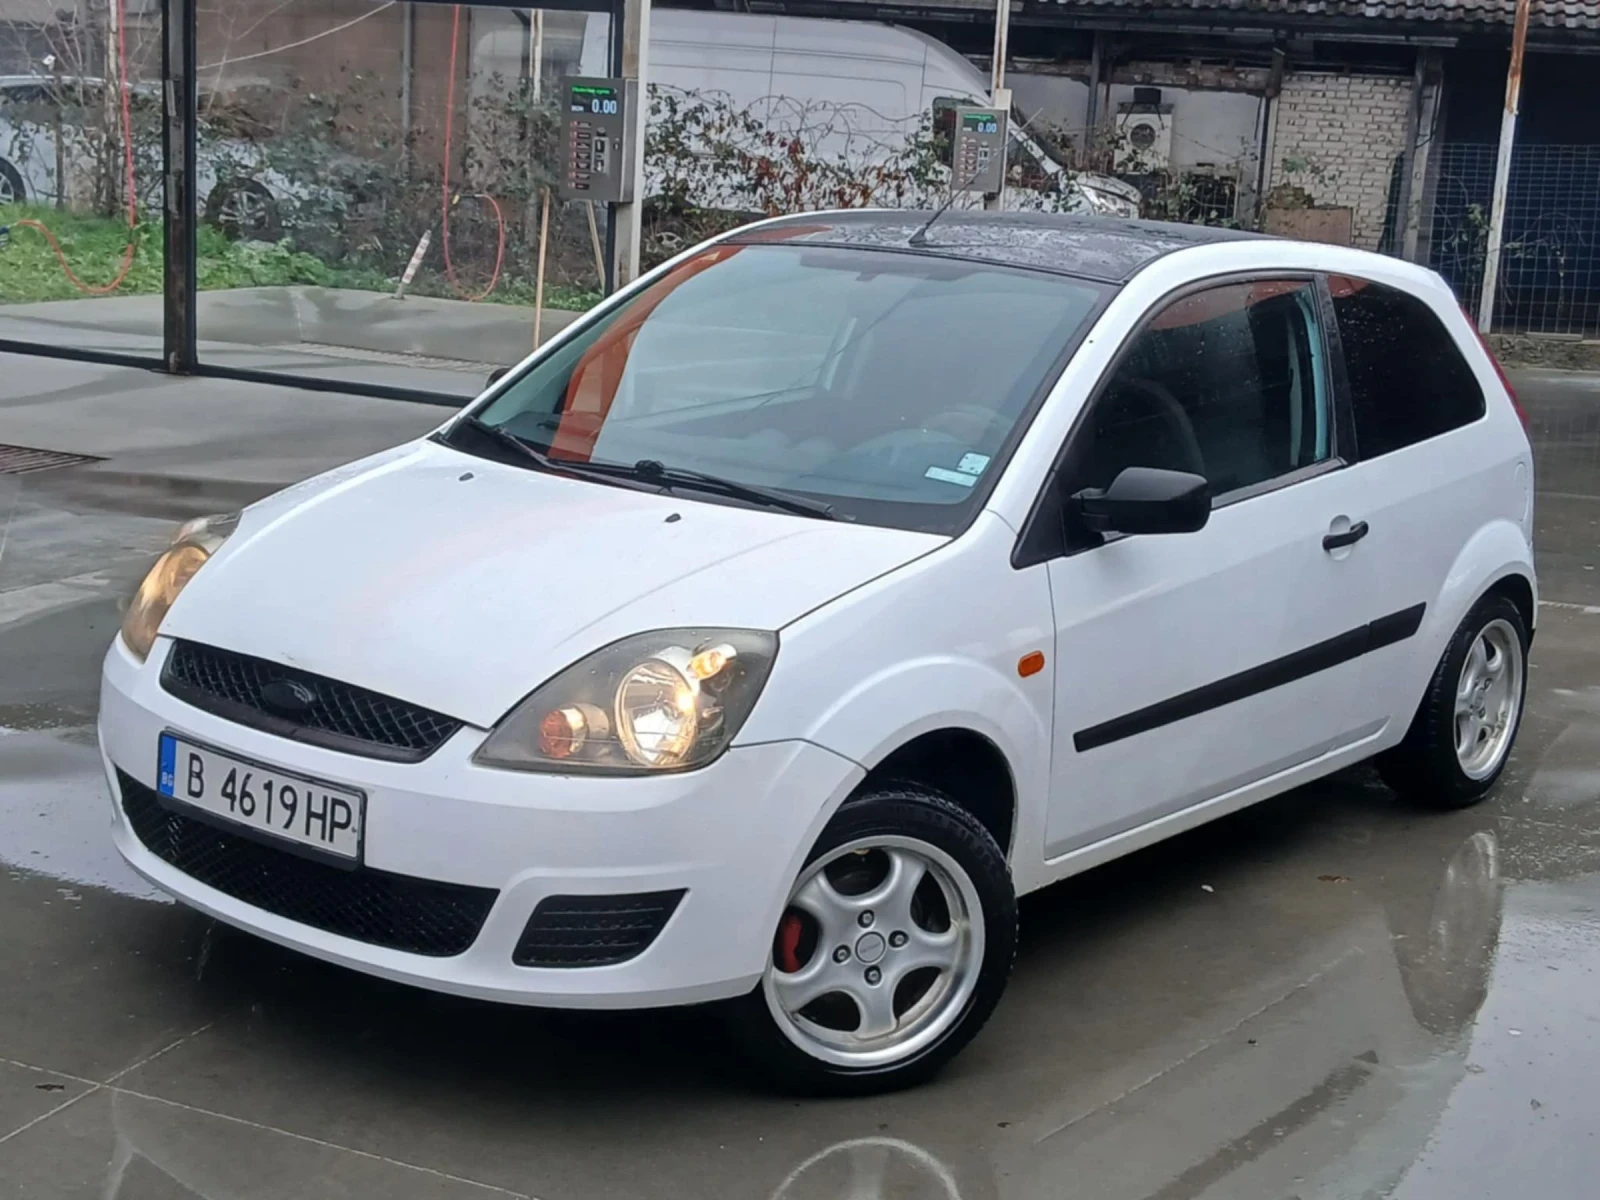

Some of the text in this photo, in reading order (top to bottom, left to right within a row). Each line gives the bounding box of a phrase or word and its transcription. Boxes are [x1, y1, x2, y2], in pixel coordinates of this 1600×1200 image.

[592, 98, 617, 114] 0.00
[188, 752, 352, 843] B 4619HP
